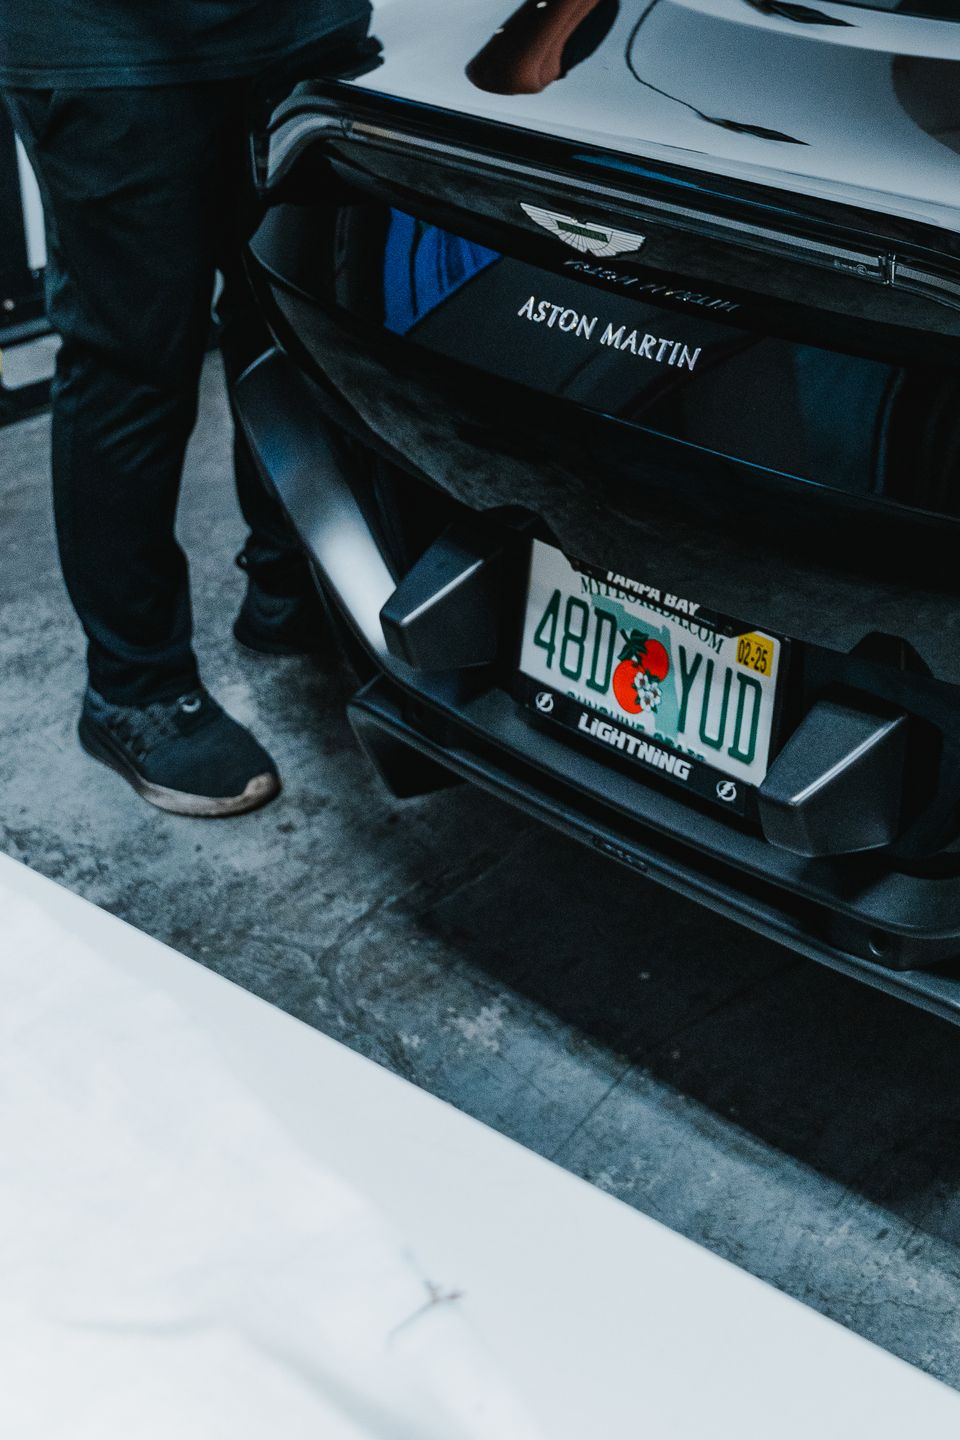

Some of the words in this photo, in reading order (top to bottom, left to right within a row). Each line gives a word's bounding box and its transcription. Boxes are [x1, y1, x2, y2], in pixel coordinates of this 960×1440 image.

[517, 295, 598, 340] ASTON
[600, 323, 702, 371] MARTIN
[606, 570, 661, 602] TAMPA
[663, 593, 701, 616] BAY
[533, 589, 617, 695] 48D
[677, 645, 763, 765] YUD
[738, 640, 768, 673] 02-25
[577, 712, 693, 781] LIGHTNING
